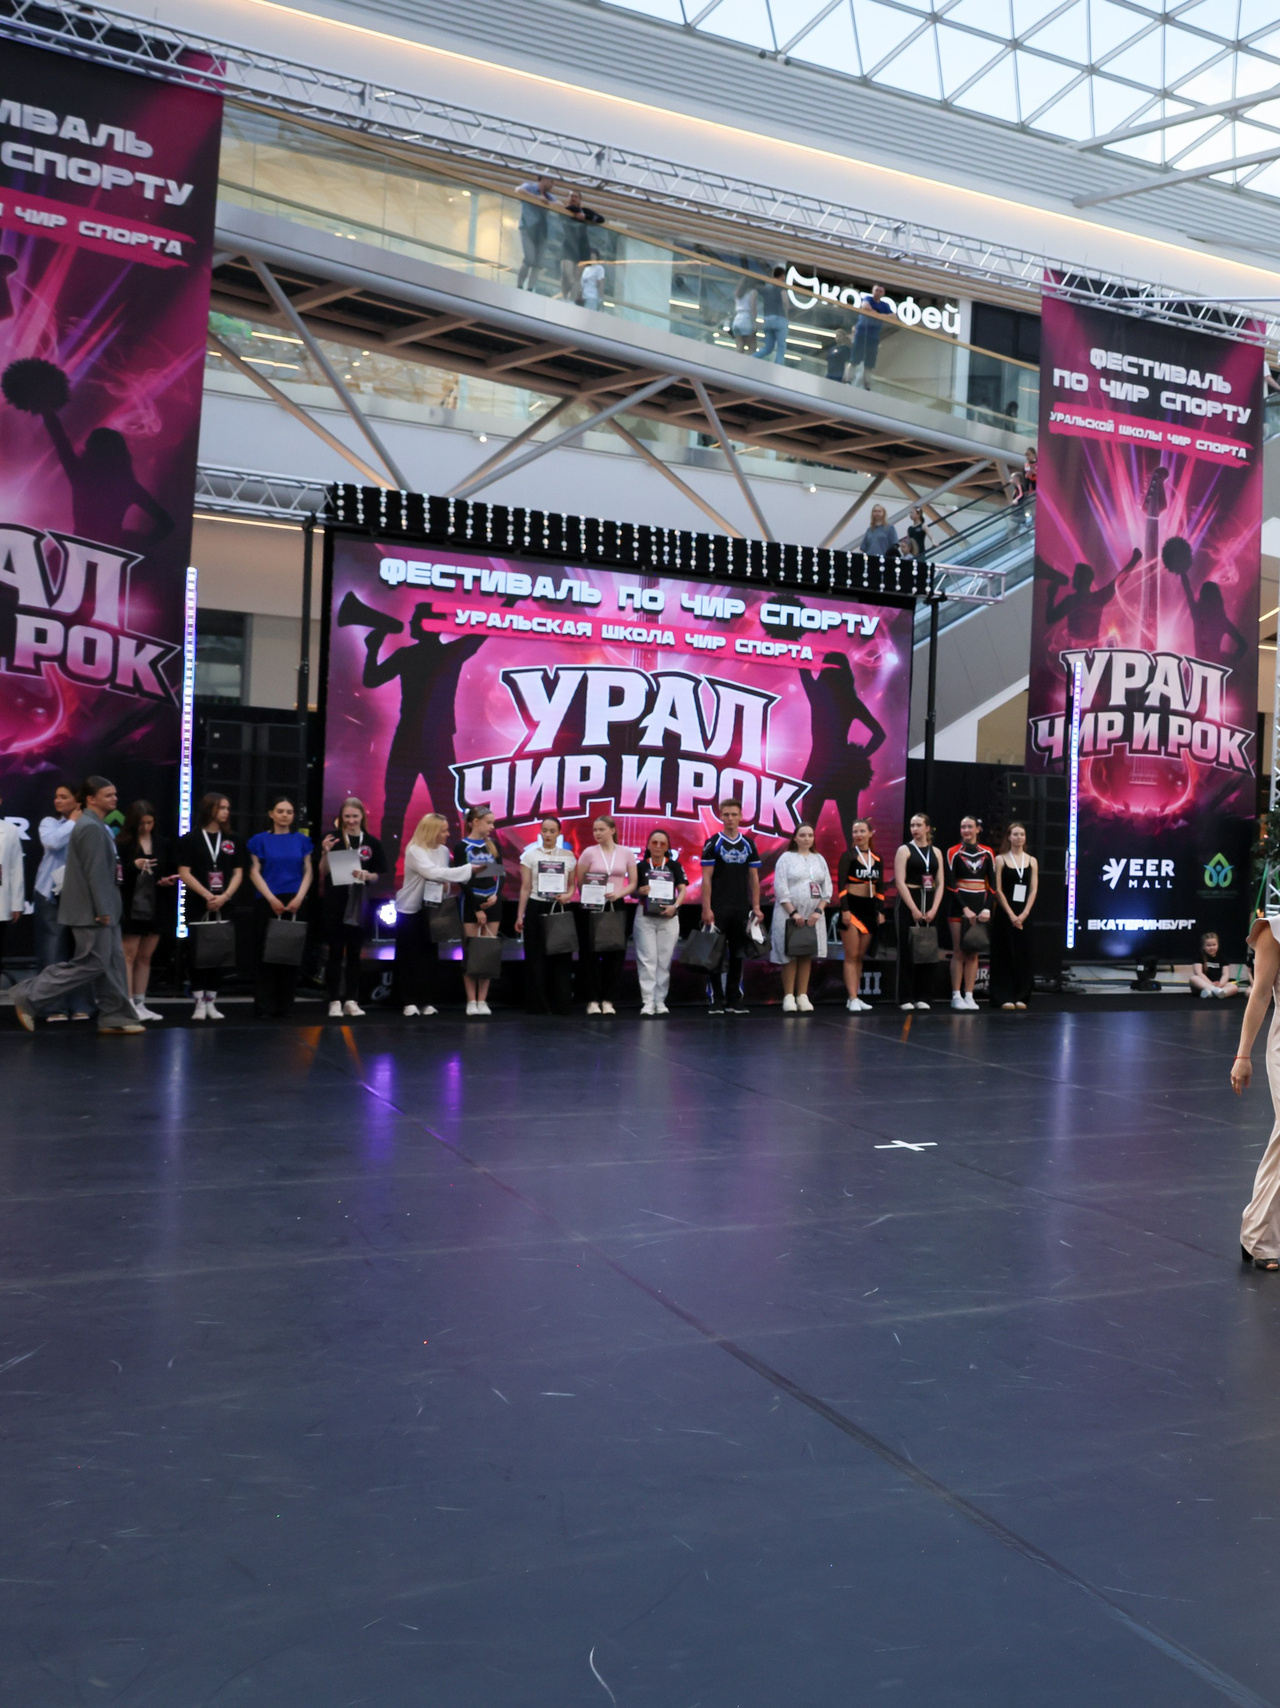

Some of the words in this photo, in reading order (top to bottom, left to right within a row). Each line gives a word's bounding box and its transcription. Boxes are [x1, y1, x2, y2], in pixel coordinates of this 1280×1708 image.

[1, 141, 194, 206] СПОРТУ
[15, 206, 67, 228] ЧИР
[79, 220, 183, 256] СПОРТА
[1053, 368, 1089, 392] ПО
[1099, 378, 1149, 403] ЧИР
[1160, 391, 1252, 425] СПОРТУ
[1090, 348, 1232, 394] ФЕСТИВАЛЬ
[1050, 411, 1114, 433] УРАЛЬСКОЙ
[1119, 424, 1162, 442] ШКОЛЫ
[1167, 433, 1191, 446] ЧИР
[1196, 439, 1247, 459] СПОРТА
[379, 557, 602, 605] ФЕСТИВАЛЬ
[618, 585, 666, 614] ПО
[680, 593, 746, 620] ЧИР
[760, 602, 880, 637] СПОРТУ
[14, 613, 165, 698] РОК
[454, 608, 593, 639] УРАЛЬСКАЯ
[601, 624, 676, 646] ШКОЛА
[684, 634, 727, 650] ЧИР
[734, 638, 814, 661] СПОРТА
[1064, 651, 1228, 722] УРАЛ
[507, 668, 772, 771] УРАЛ
[1133, 712, 1164, 753] И
[1168, 715, 1249, 769] РОК
[461, 755, 607, 822] ЧИР
[620, 755, 672, 811] И
[680, 757, 801, 830] РОК
[1128, 879, 1173, 889] MALL
[1087, 918, 1196, 931] ЕКАТЕРИНБУРГ
